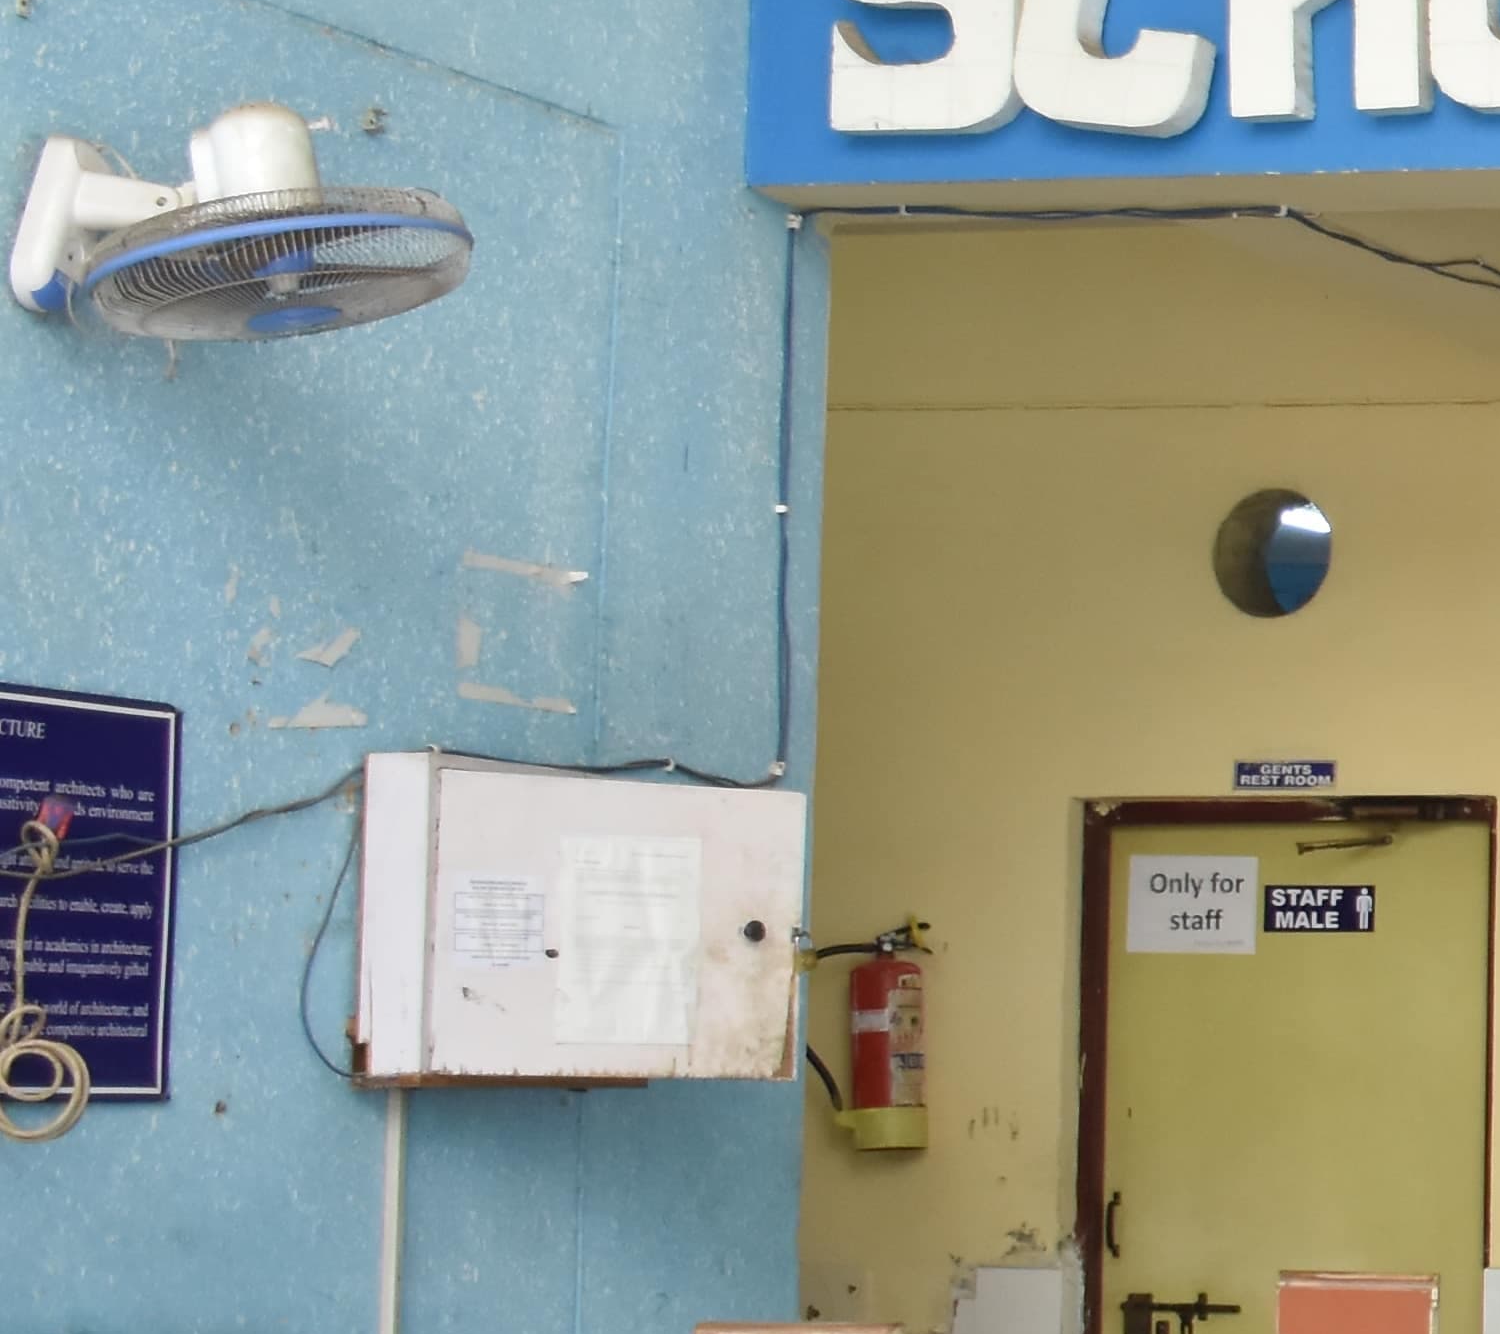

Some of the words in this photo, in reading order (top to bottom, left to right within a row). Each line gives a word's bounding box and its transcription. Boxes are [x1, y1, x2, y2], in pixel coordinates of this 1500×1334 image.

[1260, 764, 1312, 775] GENTS
[1240, 775, 1280, 786] REST
[1284, 775, 1331, 786] ROOM
[55, 781, 106, 797] architects
[111, 785, 134, 802] who
[138, 791, 155, 802] are
[88, 805, 154, 822] environment
[1150, 872, 1204, 899] Only
[1210, 872, 1245, 893] for
[1271, 888, 1344, 907] STAFF
[1170, 908, 1223, 930] staff
[1275, 911, 1339, 929] MALE
